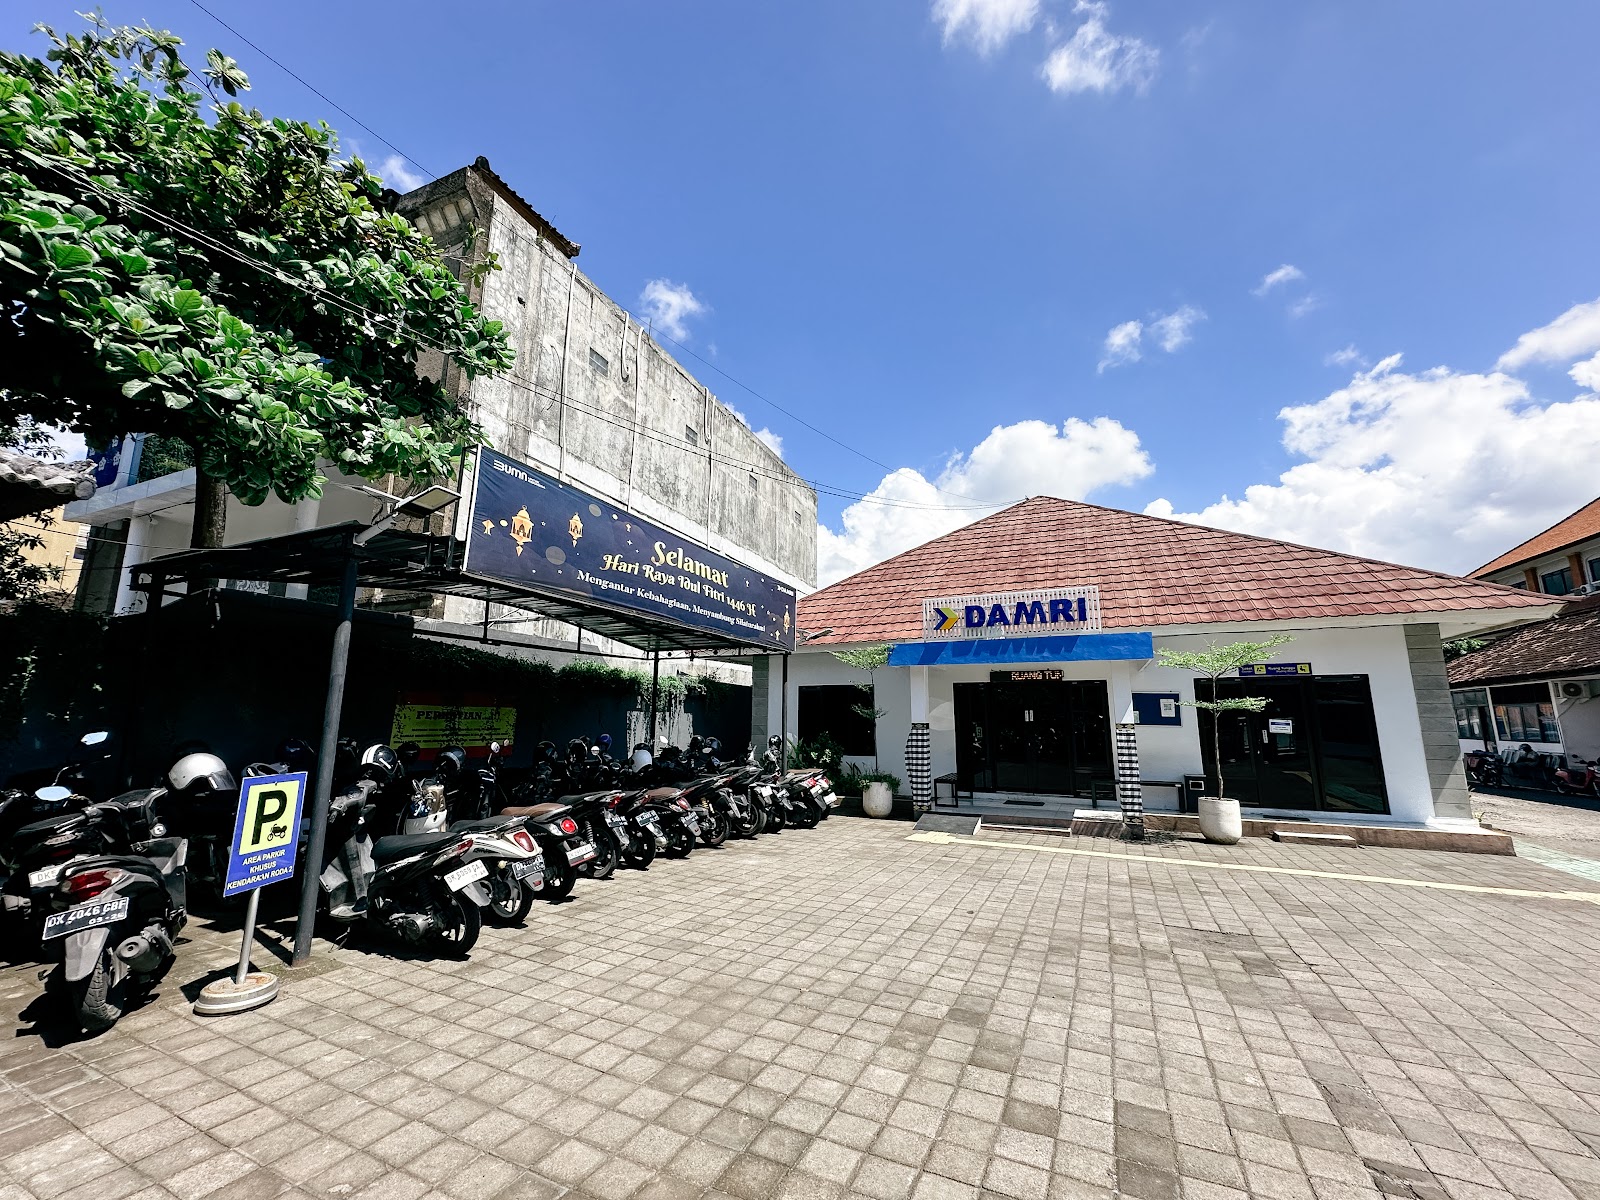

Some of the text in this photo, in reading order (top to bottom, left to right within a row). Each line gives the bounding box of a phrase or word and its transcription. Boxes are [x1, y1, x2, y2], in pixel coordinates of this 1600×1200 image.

[651, 541, 729, 588] Selamat
[577, 570, 635, 595] Mengantar
[636, 587, 691, 612] Kebahagiaan,
[692, 604, 736, 626] Menyambung
[600, 554, 757, 617] Hari Raya Idul Fitri 1446 H
[964, 597, 1088, 629] DAMRI
[1011, 671, 1043, 681] RUANG
[251, 789, 288, 846] P
[243, 849, 286, 866] AREA PARKIR
[250, 861, 277, 874] KHUSUS
[270, 867, 289, 878] RODA
